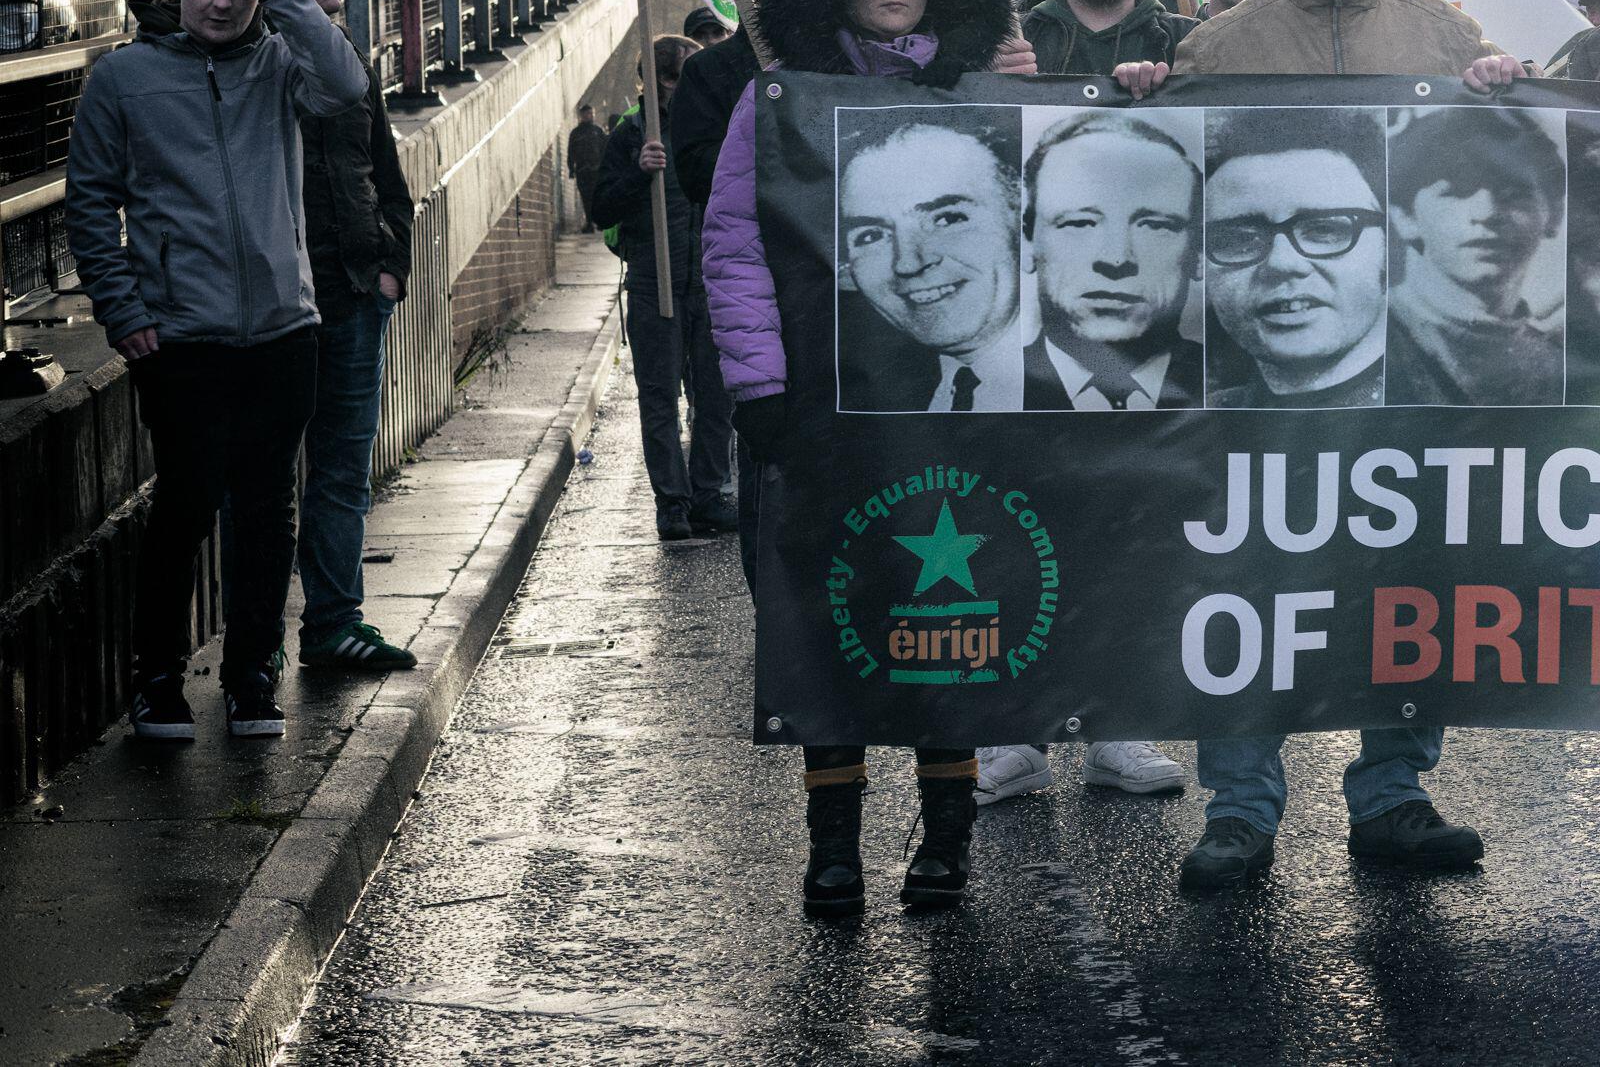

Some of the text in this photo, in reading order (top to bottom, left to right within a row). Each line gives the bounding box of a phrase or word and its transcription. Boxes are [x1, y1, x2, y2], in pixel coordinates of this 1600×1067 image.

[826, 464, 1060, 679] Liberty Equality Community
[1181, 590, 1335, 696] OF
